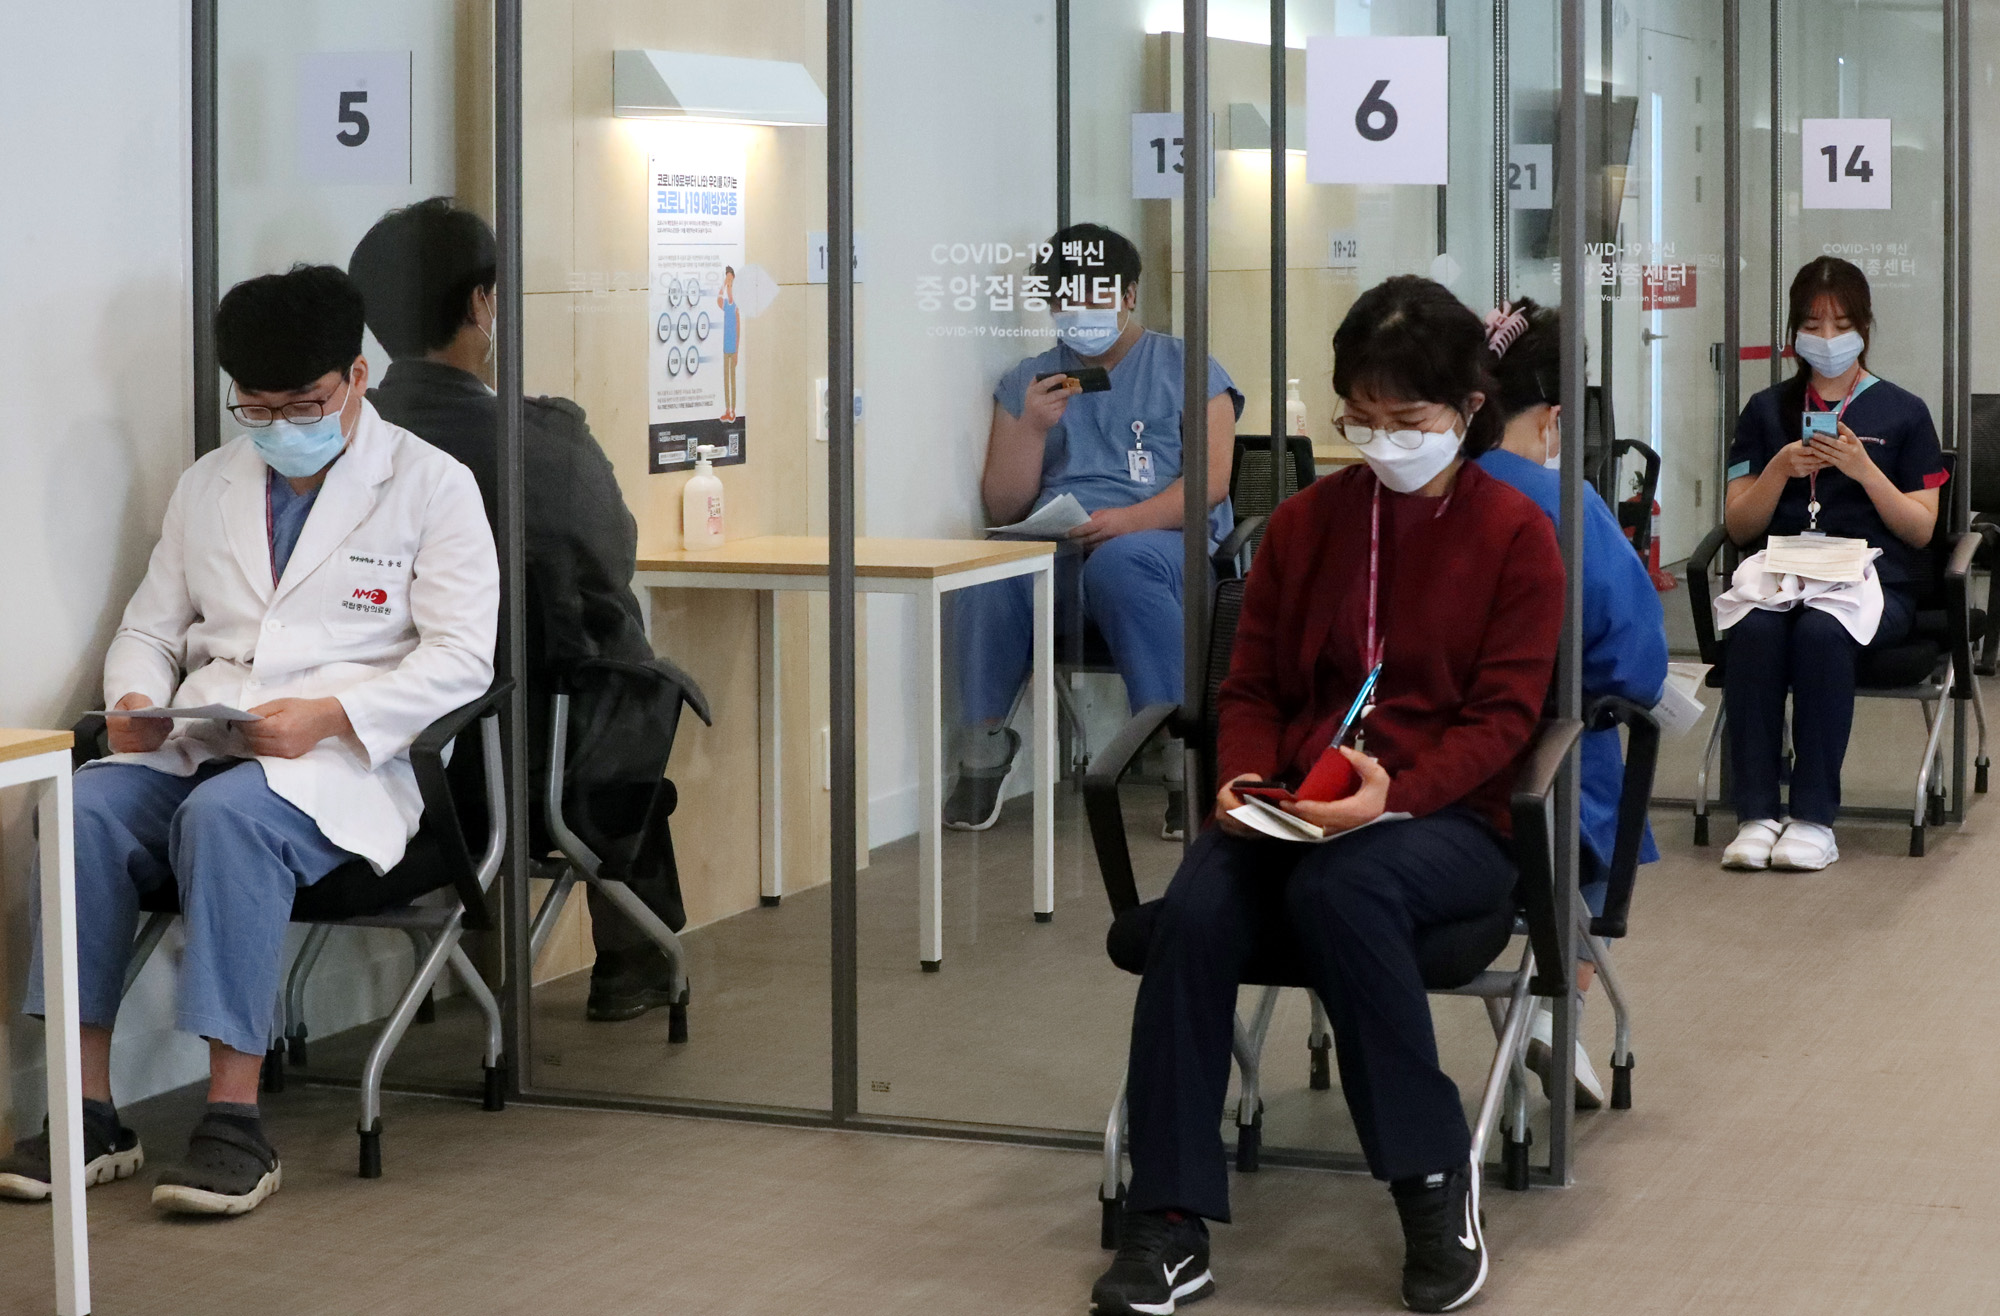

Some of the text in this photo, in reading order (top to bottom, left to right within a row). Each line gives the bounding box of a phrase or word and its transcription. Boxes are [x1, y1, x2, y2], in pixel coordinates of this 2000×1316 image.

[336, 91, 370, 147] 5
[1355, 79, 1398, 141] 6
[1507, 163, 1537, 190] 21
[1820, 145, 1874, 182] 14
[657, 174, 697, 187] 코로나19로부터
[657, 190, 738, 216] 코로나19 예방접종
[931, 240, 1105, 266] COVID-19 백신
[1822, 242, 1908, 256] COVID-19 백신
[914, 273, 1122, 312] 중앙접종센터
[927, 326, 1112, 337] COVID-19 Vaccination Center
[352, 588, 385, 602] NMC
